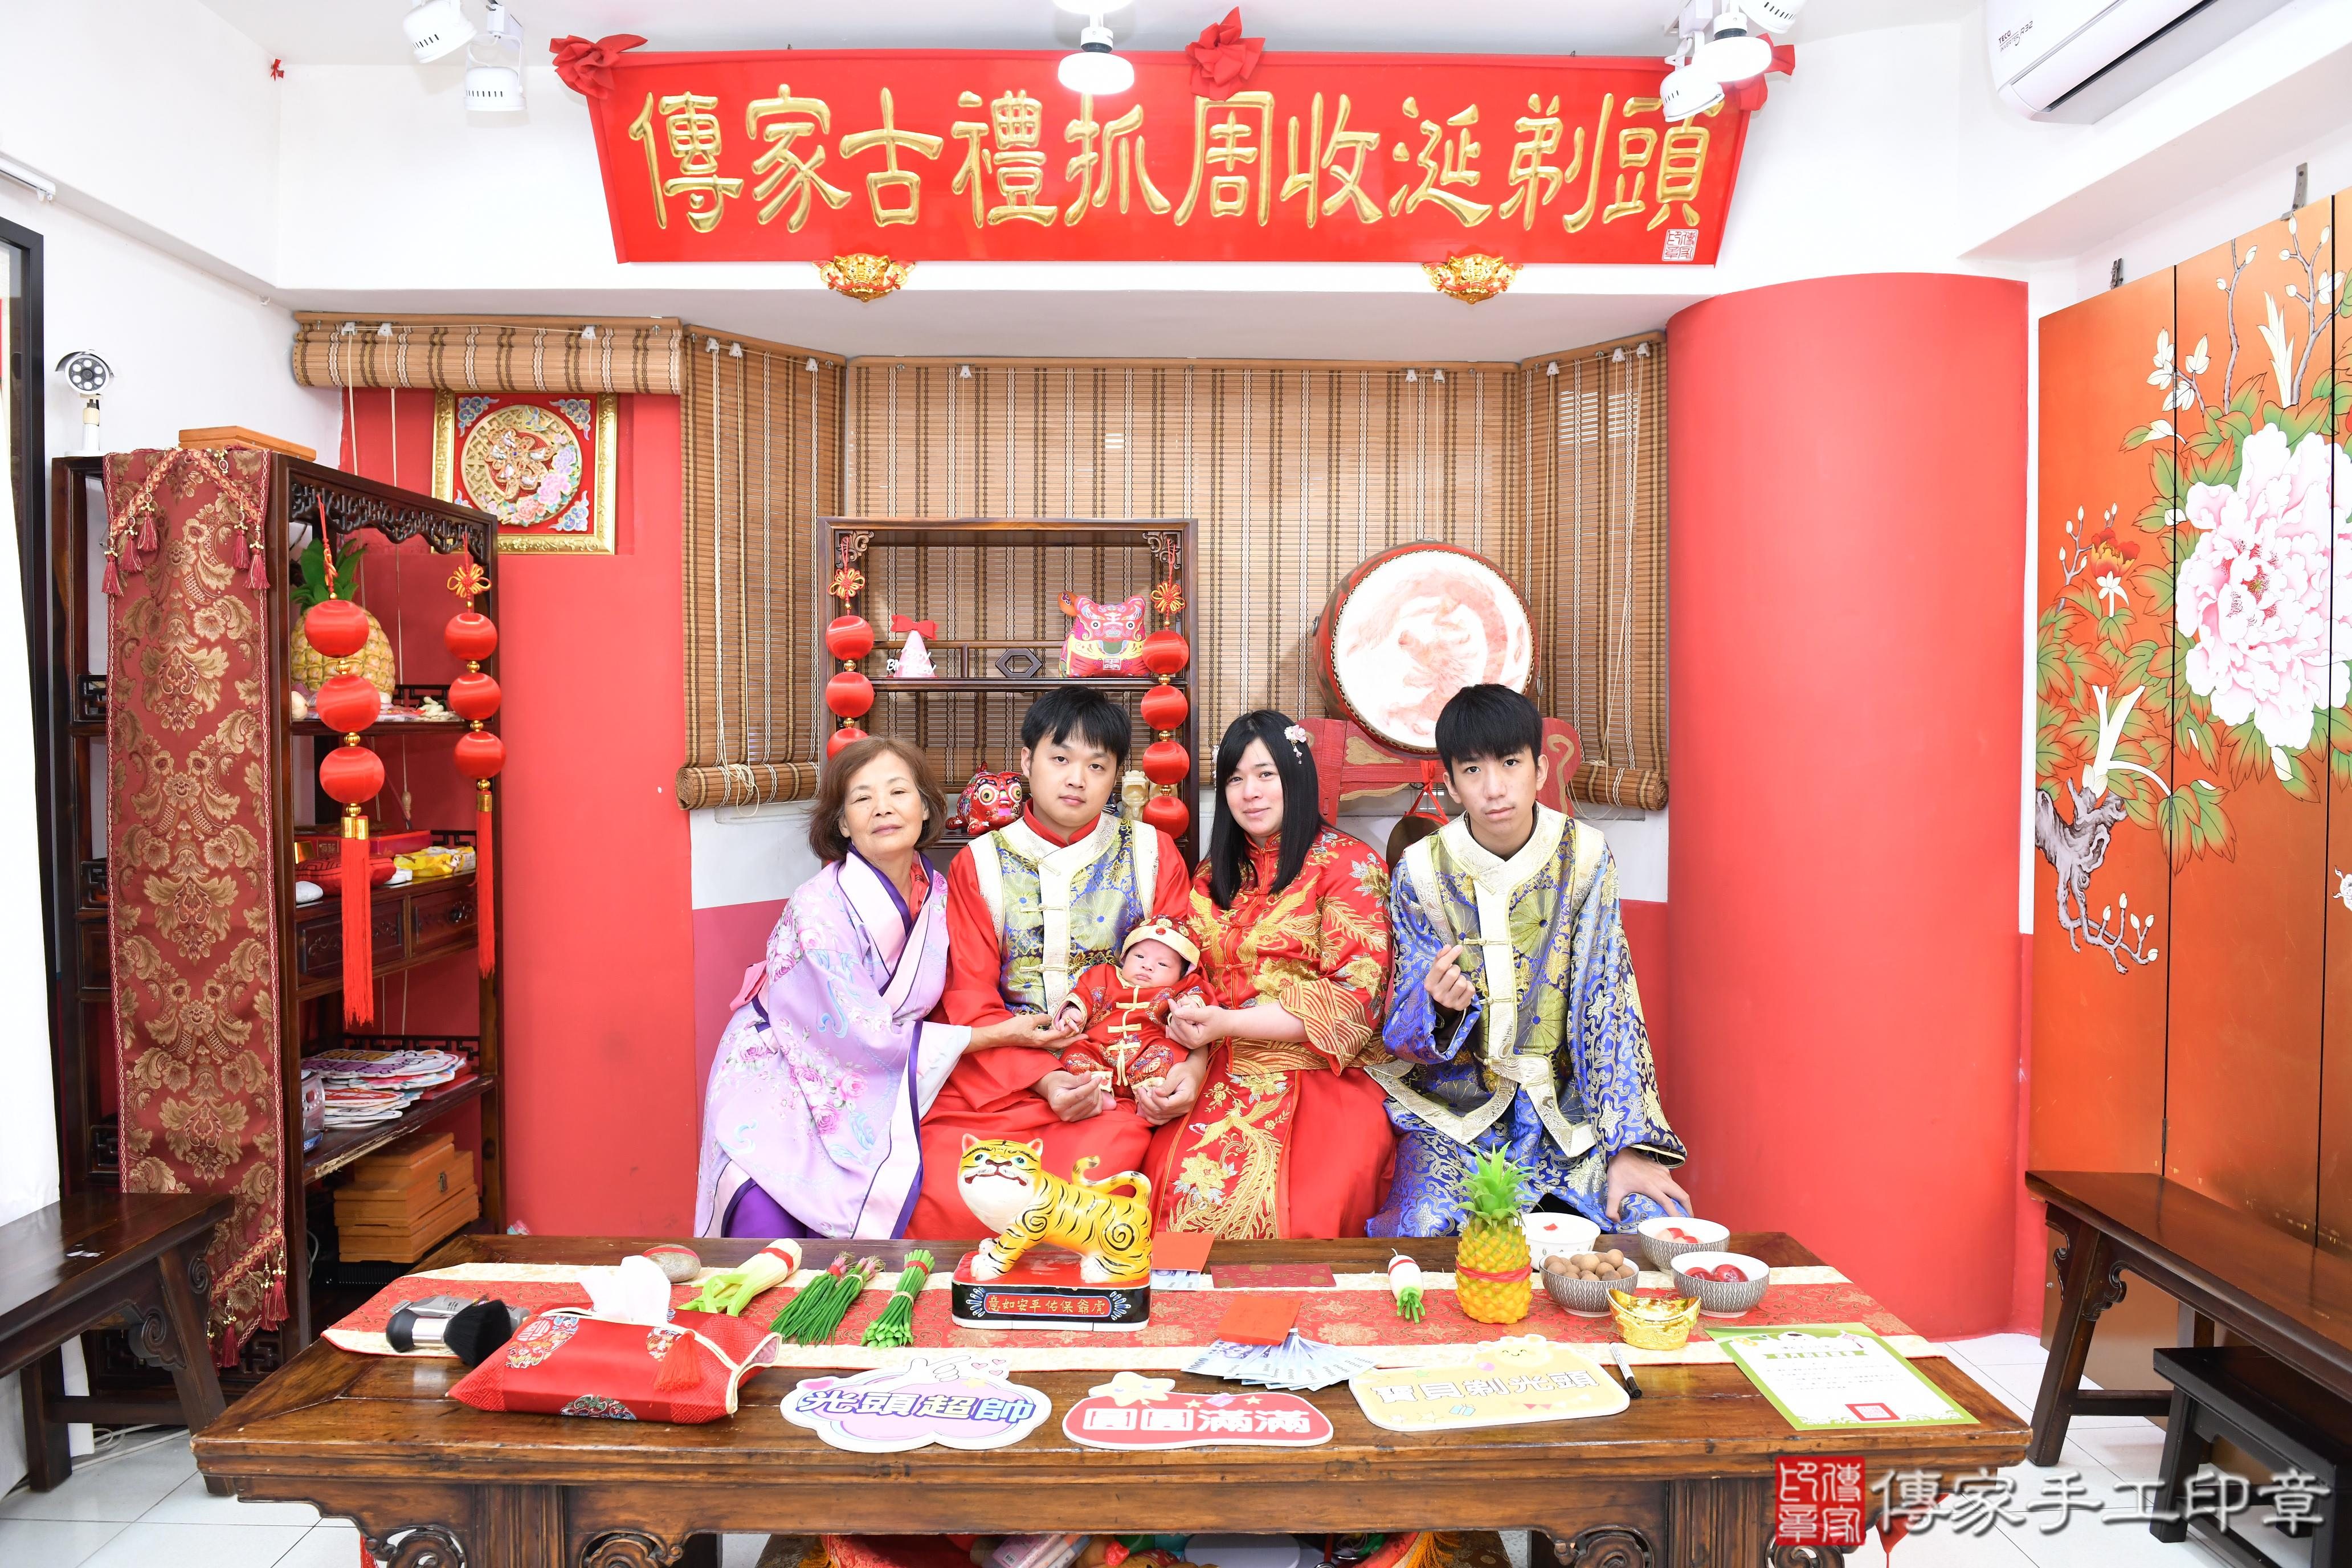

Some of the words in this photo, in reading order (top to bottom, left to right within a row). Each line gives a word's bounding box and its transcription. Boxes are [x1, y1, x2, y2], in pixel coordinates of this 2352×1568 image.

[2020, 21, 2033, 36] R32
[1999, 30, 2011, 44] TECO
[627, 83, 1725, 234] 傳家古禮抓周收涎剃頭
[1188, 1358, 1208, 1370] 1000
[1333, 1364, 1350, 1373] 1000
[1344, 1360, 1363, 1369] 1000
[1306, 1369, 1318, 1381] 1000
[1322, 1366, 1336, 1377] 1000
[1370, 1370, 1600, 1404] 寶貝剃光頭
[795, 1390, 1037, 1423] 光頭超帥
[1082, 1408, 1311, 1434] 圓圓滿滿
